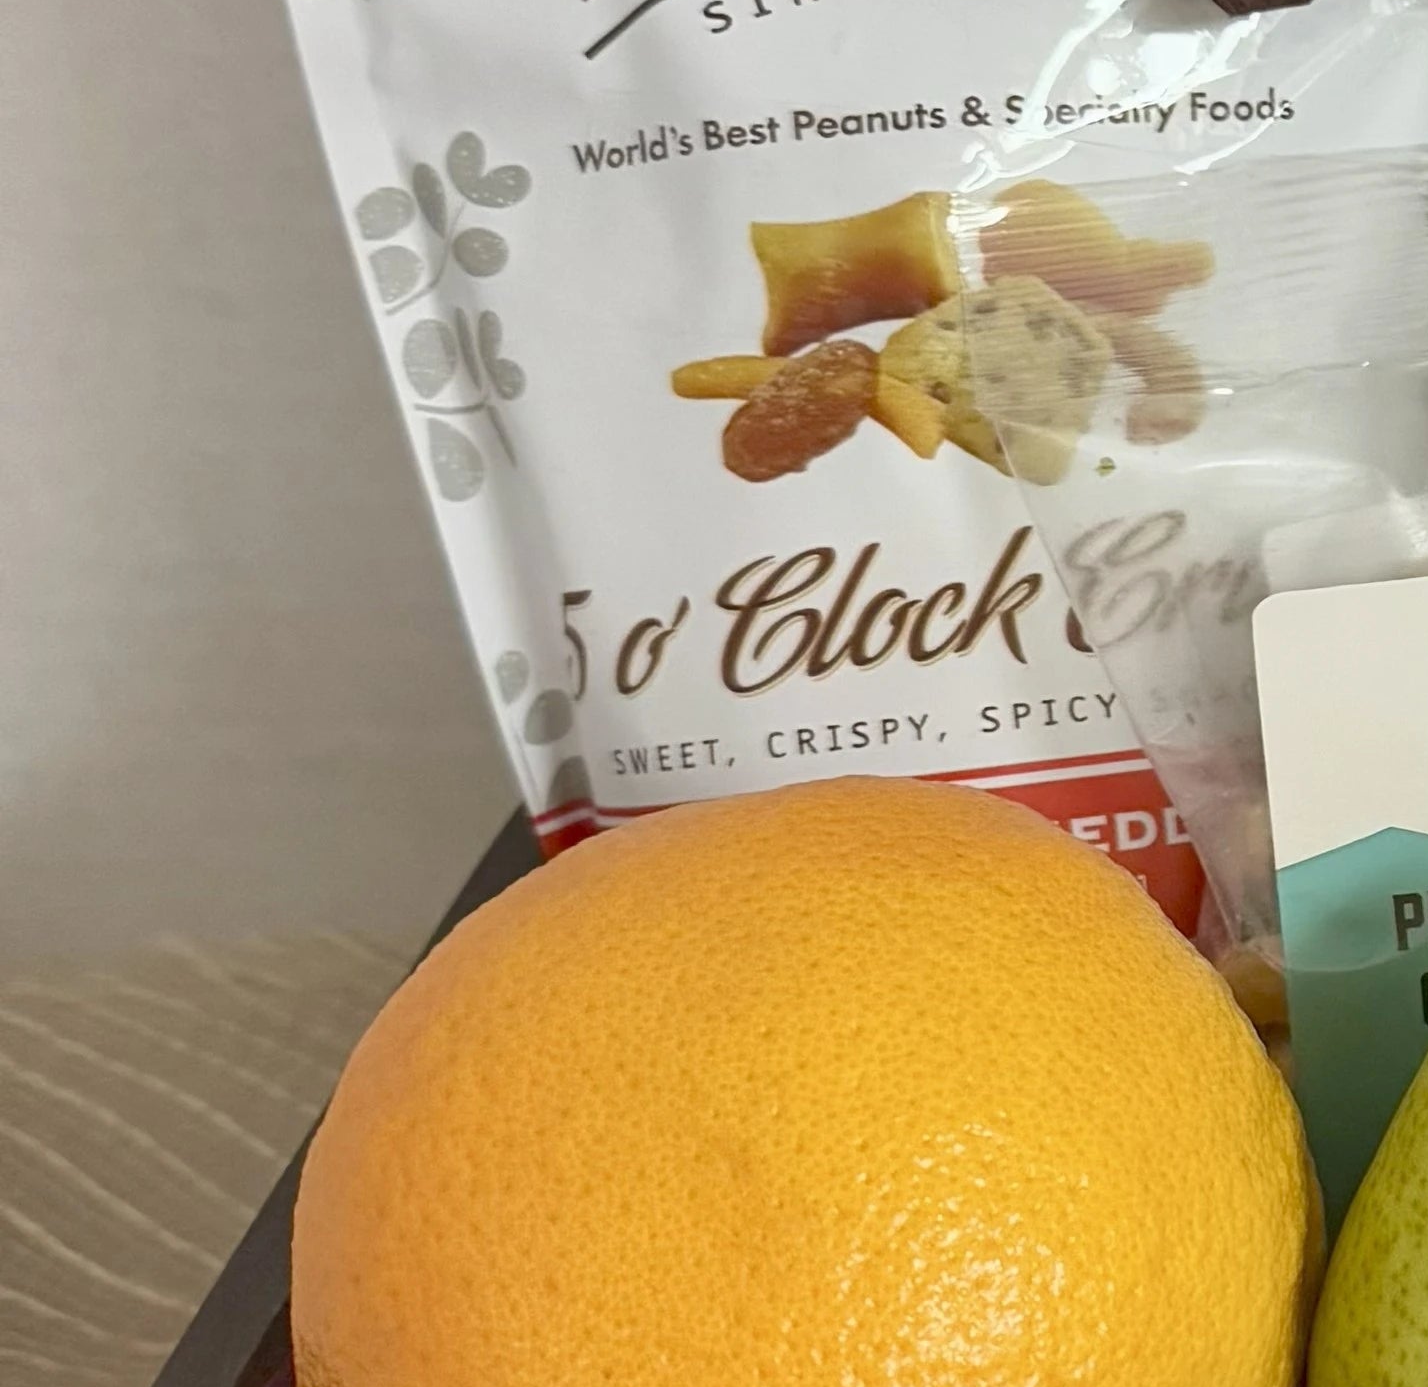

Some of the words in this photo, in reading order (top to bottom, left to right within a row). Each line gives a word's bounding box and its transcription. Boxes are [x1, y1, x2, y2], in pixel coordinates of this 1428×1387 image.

[573, 125, 693, 175] World's
[703, 114, 780, 151] Best
[792, 101, 947, 142] Peanuts
[961, 96, 990, 128] &
[1190, 87, 1295, 123] Foods
[716, 525, 1044, 695] Clock
[611, 737, 738, 778] SWEET,
[765, 714, 947, 760] CRISPY,
[980, 693, 1118, 734] SPICY
